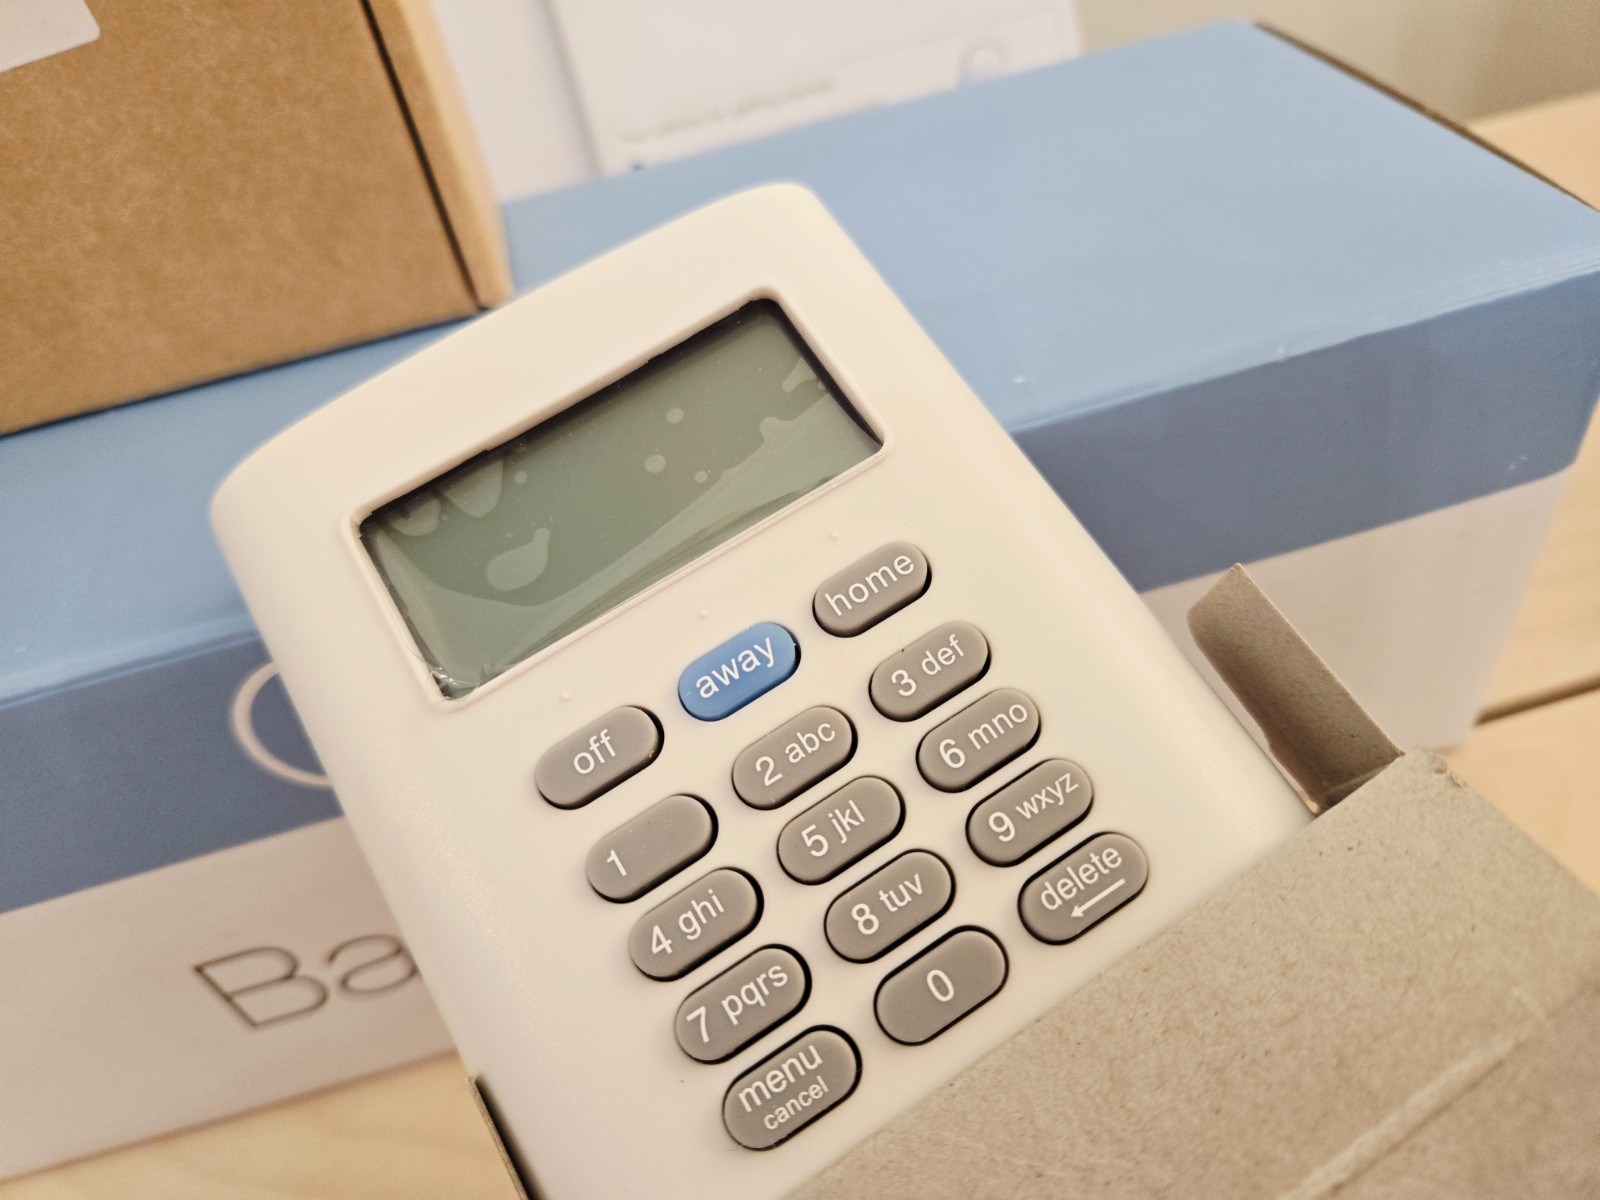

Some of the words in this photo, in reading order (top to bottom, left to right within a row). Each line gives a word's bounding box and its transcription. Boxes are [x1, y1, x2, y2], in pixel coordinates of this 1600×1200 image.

[825, 555, 914, 616] home
[695, 637, 775, 699] away
[890, 669, 917, 697] 3
[921, 634, 965, 676] def
[573, 729, 617, 775] off
[754, 755, 783, 787] 2
[784, 722, 836, 764] abc
[938, 738, 966, 769] 6
[968, 704, 1028, 750] mno
[801, 824, 829, 857] 5
[827, 800, 866, 844] jkl
[988, 811, 1016, 843] 9
[1015, 773, 1079, 821] wxyz
[606, 849, 628, 877] 1
[1040, 847, 1123, 911] delete
[649, 925, 673, 956] 4
[678, 889, 725, 940] ghi
[851, 903, 880, 935] 8
[879, 873, 924, 913] tuv
[686, 1006, 710, 1043] 7
[721, 965, 789, 1026] pqrs
[926, 969, 955, 1002] 0
[737, 1044, 823, 1112] menu
[763, 1076, 830, 1130] cancel
